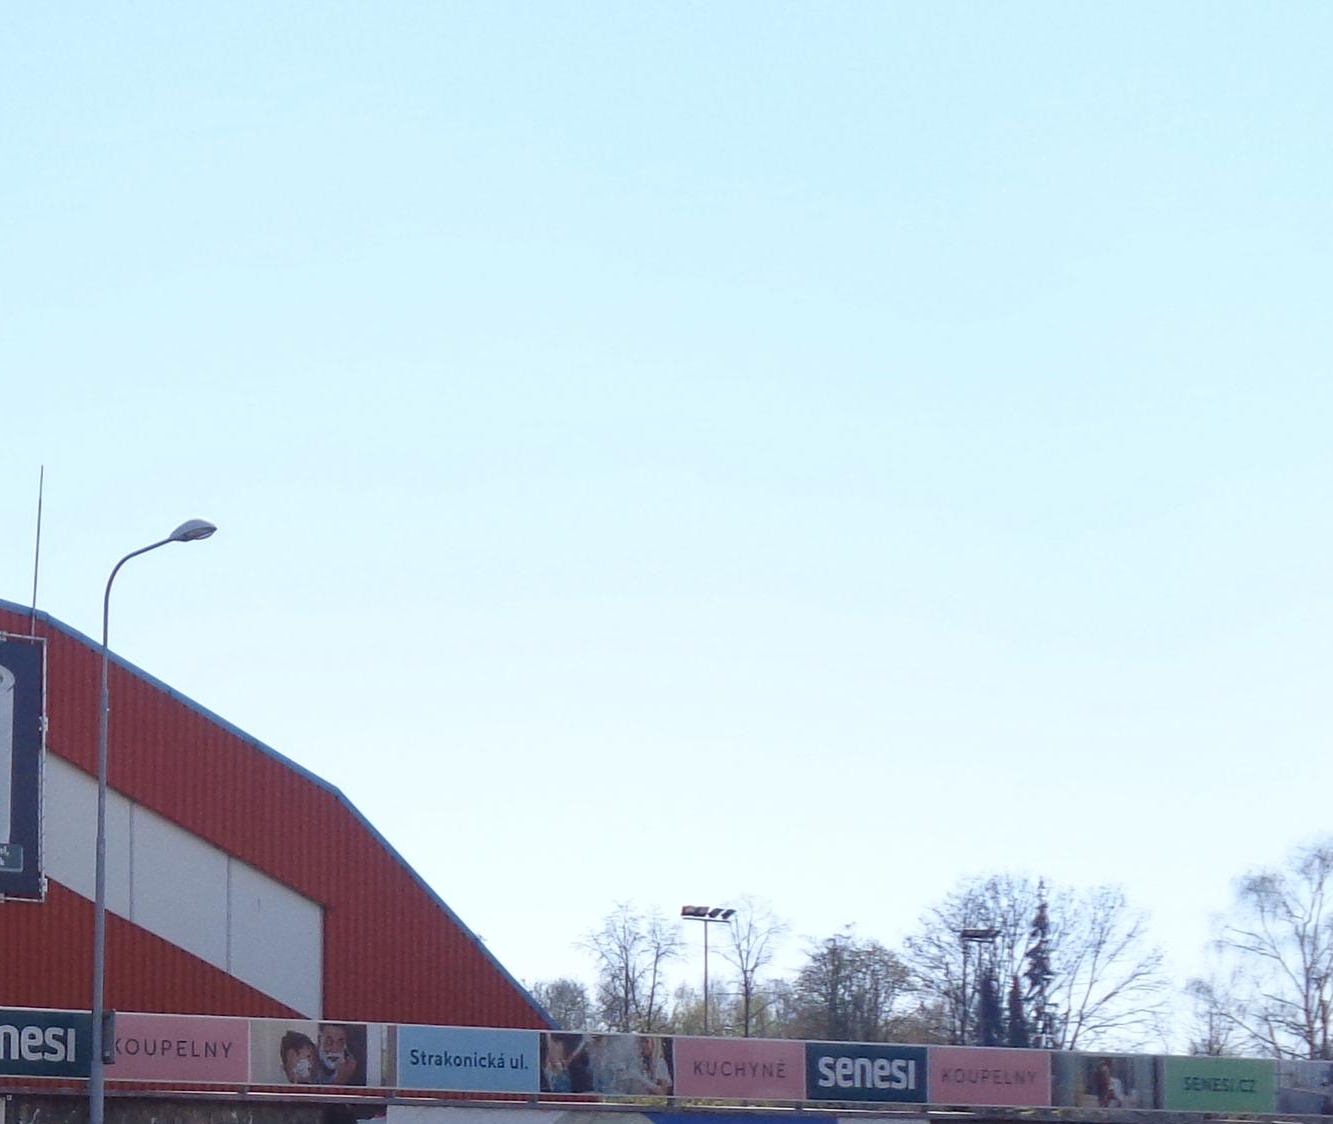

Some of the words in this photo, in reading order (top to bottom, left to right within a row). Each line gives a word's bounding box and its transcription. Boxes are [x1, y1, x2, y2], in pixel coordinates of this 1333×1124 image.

[410, 1049, 505, 1069] Strakonická
[510, 1053, 529, 1070] ul.
[942, 1067, 1037, 1085] KOUPELNY
